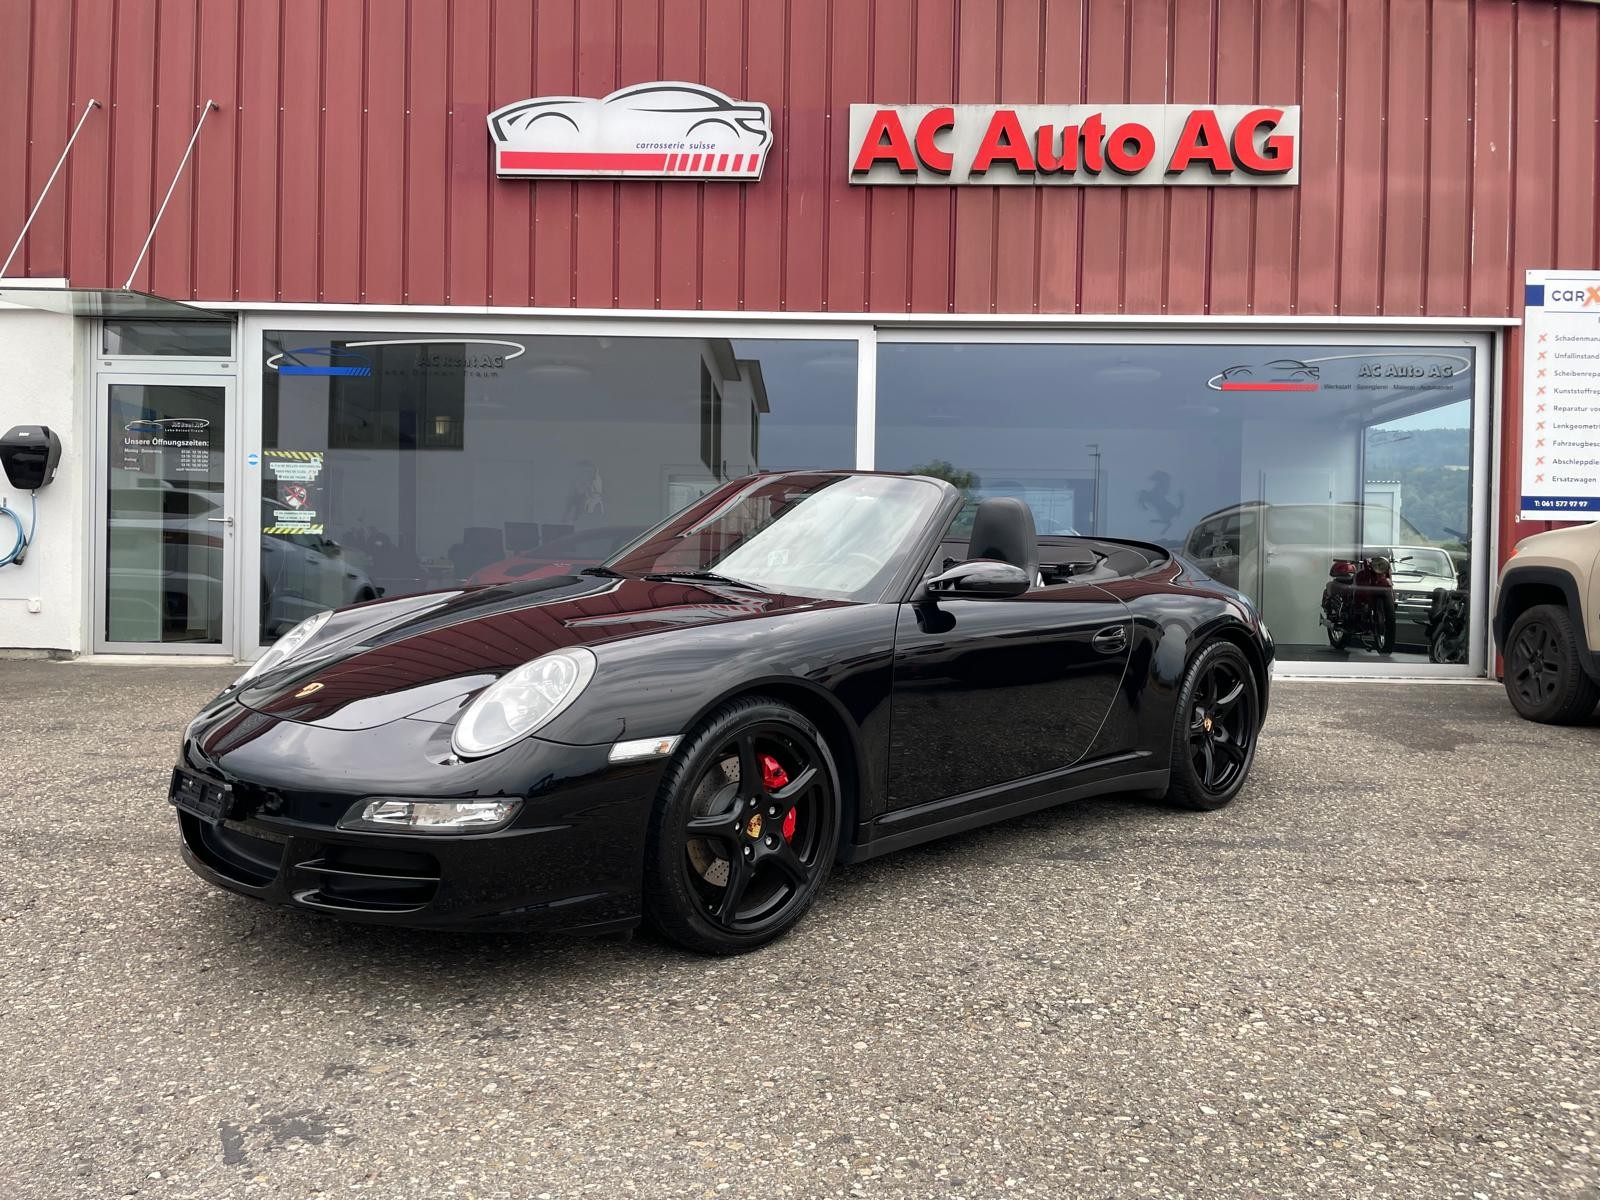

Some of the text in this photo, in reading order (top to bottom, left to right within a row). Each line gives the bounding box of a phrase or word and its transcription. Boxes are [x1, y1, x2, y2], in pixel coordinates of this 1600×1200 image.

[636, 141, 716, 150] carrosserie suisse
[852, 107, 1294, 176] AC Auto AG
[1358, 363, 1453, 378] AC Auto AG
[124, 436, 209, 447] Unsere Öffnungszeiten:
[1551, 475, 1597, 484] Ersatzwagen
